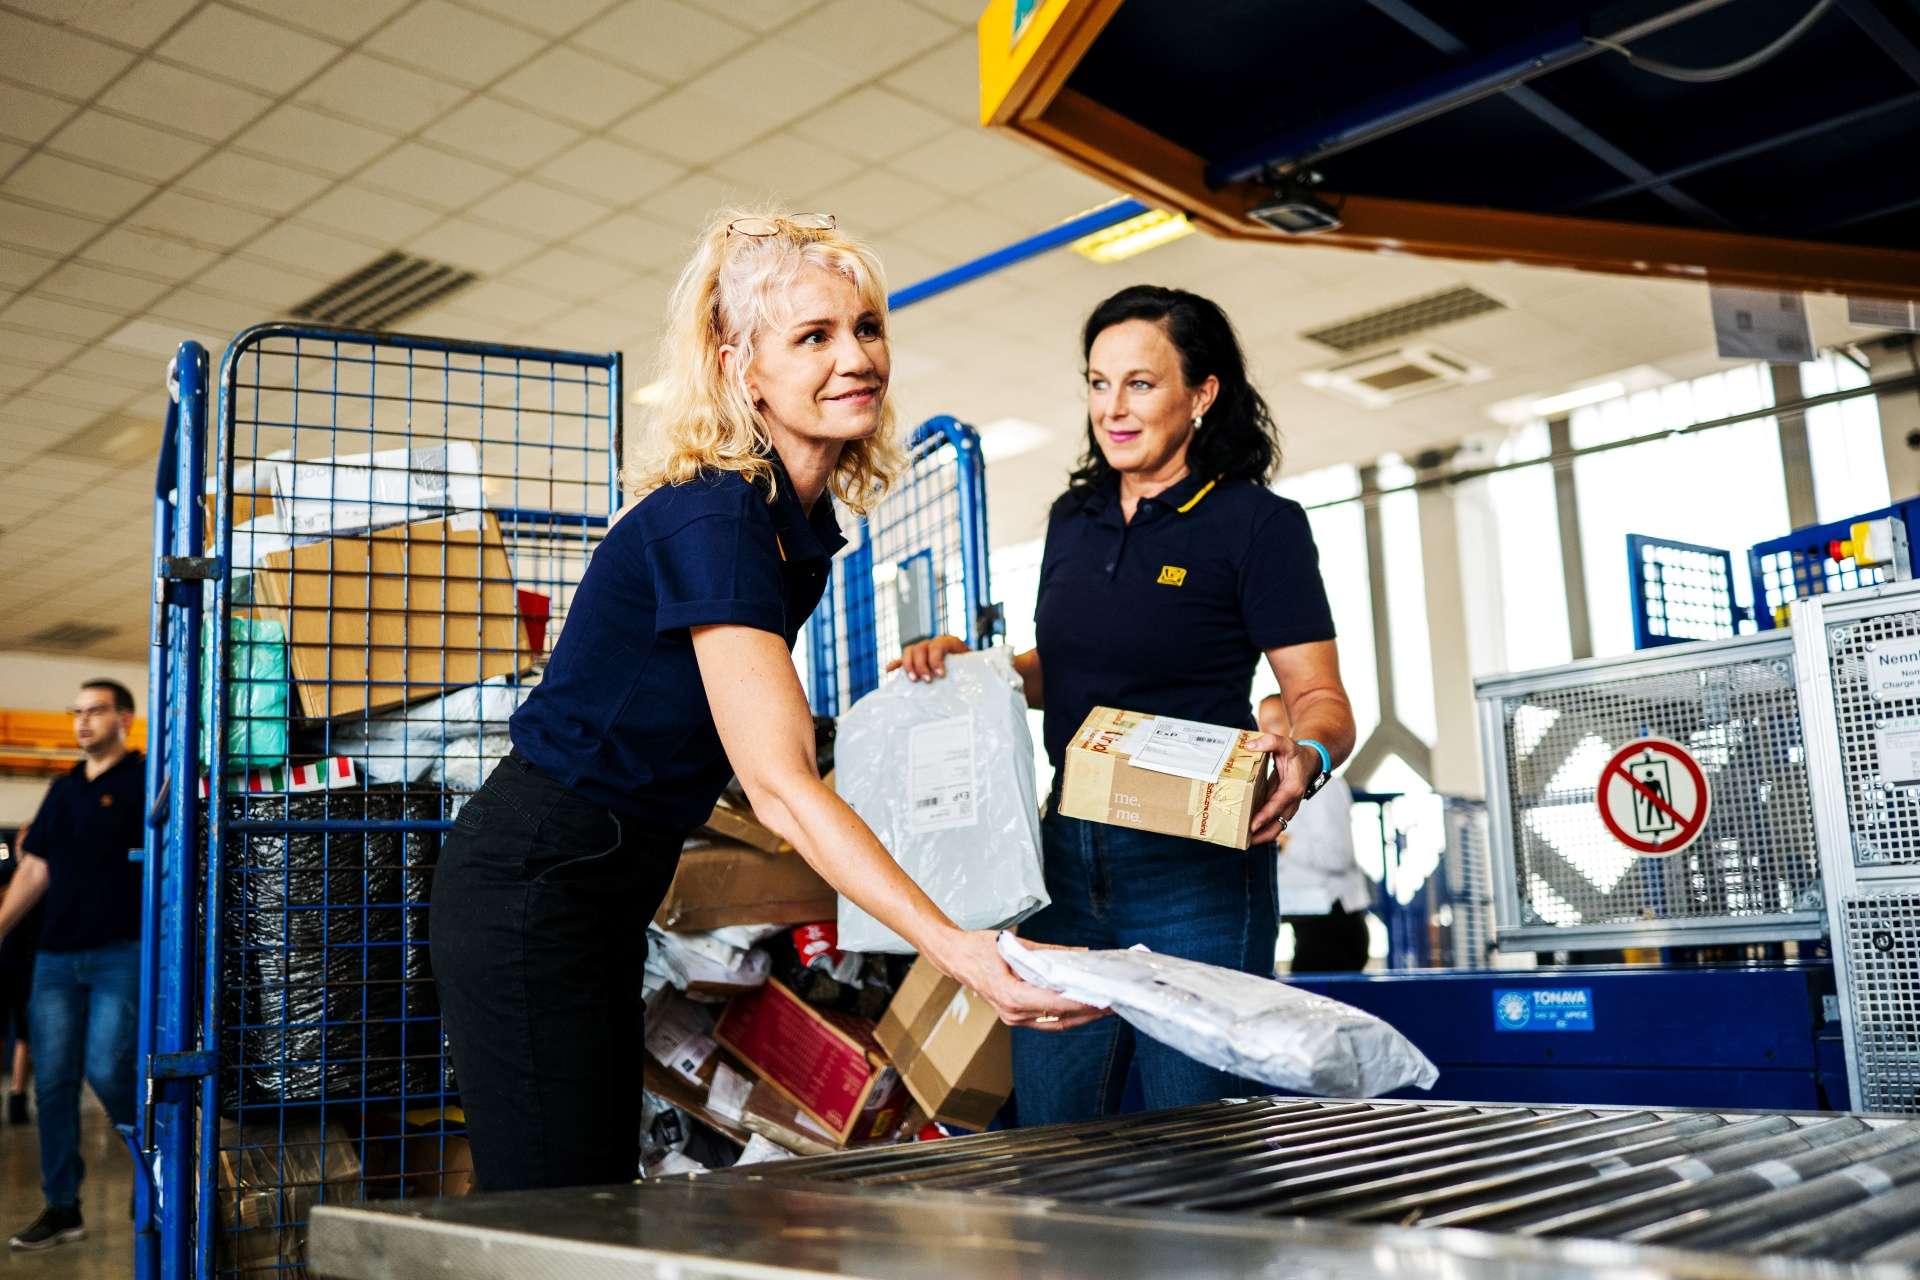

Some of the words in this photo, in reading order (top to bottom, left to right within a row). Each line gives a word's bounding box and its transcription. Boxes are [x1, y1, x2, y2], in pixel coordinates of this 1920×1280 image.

[1882, 680, 1914, 690] Charge
[1115, 793, 1141, 807] me.
[1117, 809, 1142, 823] me.
